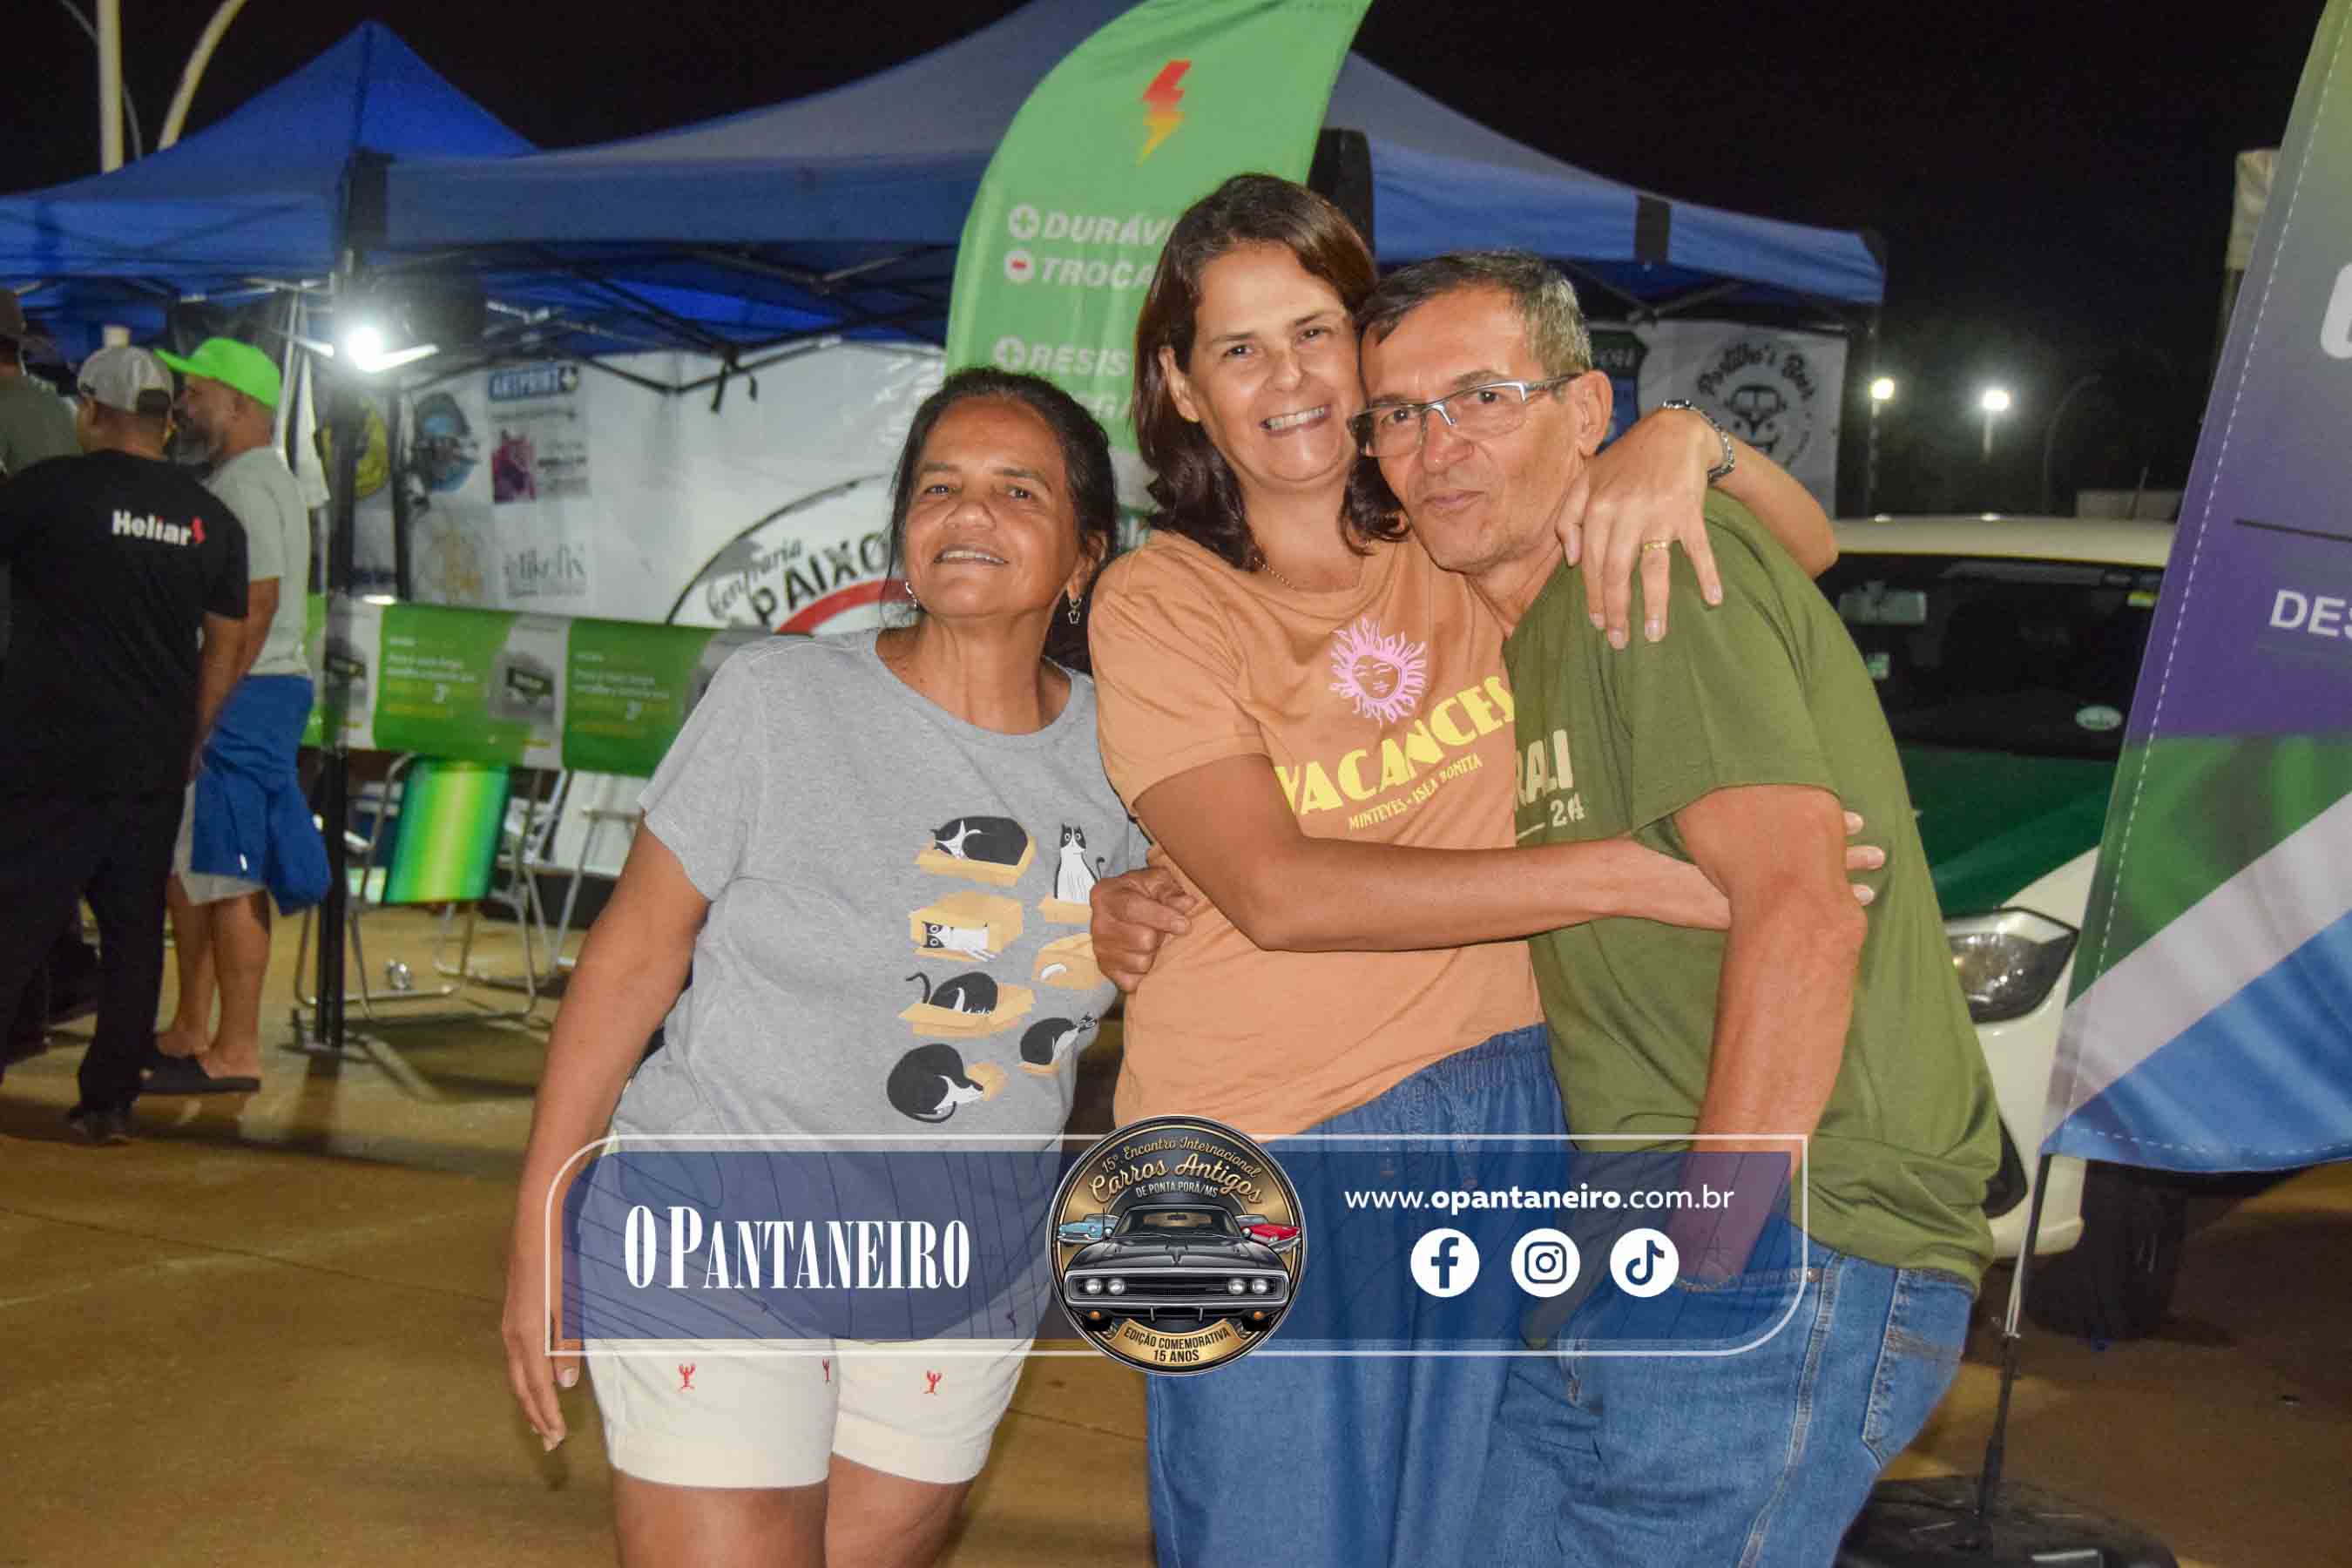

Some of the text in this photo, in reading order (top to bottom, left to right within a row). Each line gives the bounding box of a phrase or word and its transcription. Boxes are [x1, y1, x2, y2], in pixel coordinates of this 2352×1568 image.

[112, 510, 192, 545] Heliar
[728, 531, 890, 629] PAIXO
[2269, 589, 2352, 642] DE
